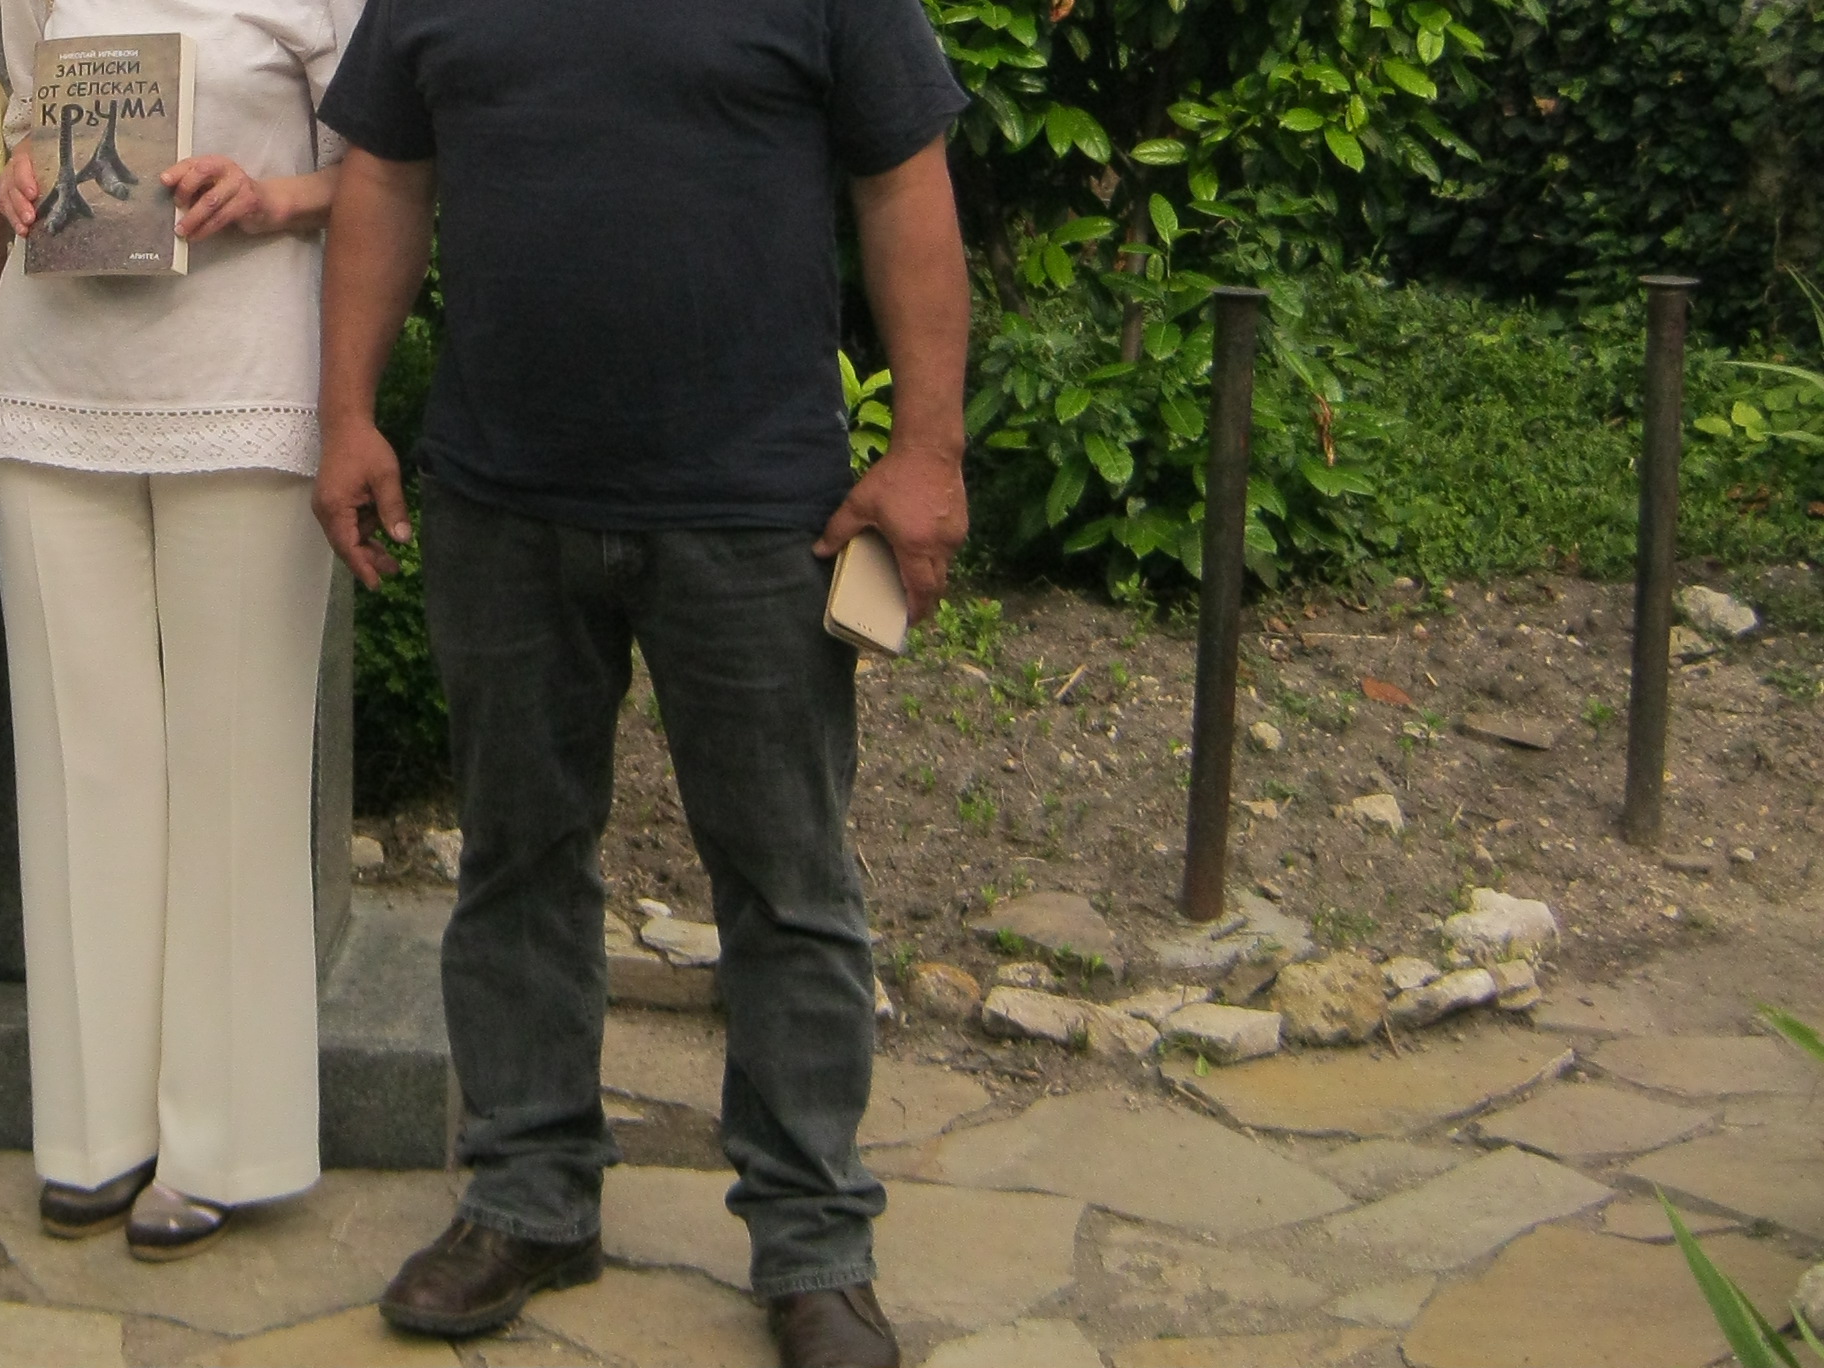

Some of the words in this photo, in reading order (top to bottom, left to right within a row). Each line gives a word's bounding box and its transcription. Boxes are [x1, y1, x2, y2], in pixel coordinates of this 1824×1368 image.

[56, 60, 140, 78] ЗАПИСКИ
[37, 85, 60, 100] ОТ
[66, 81, 161, 97] СЕЛСКАТА
